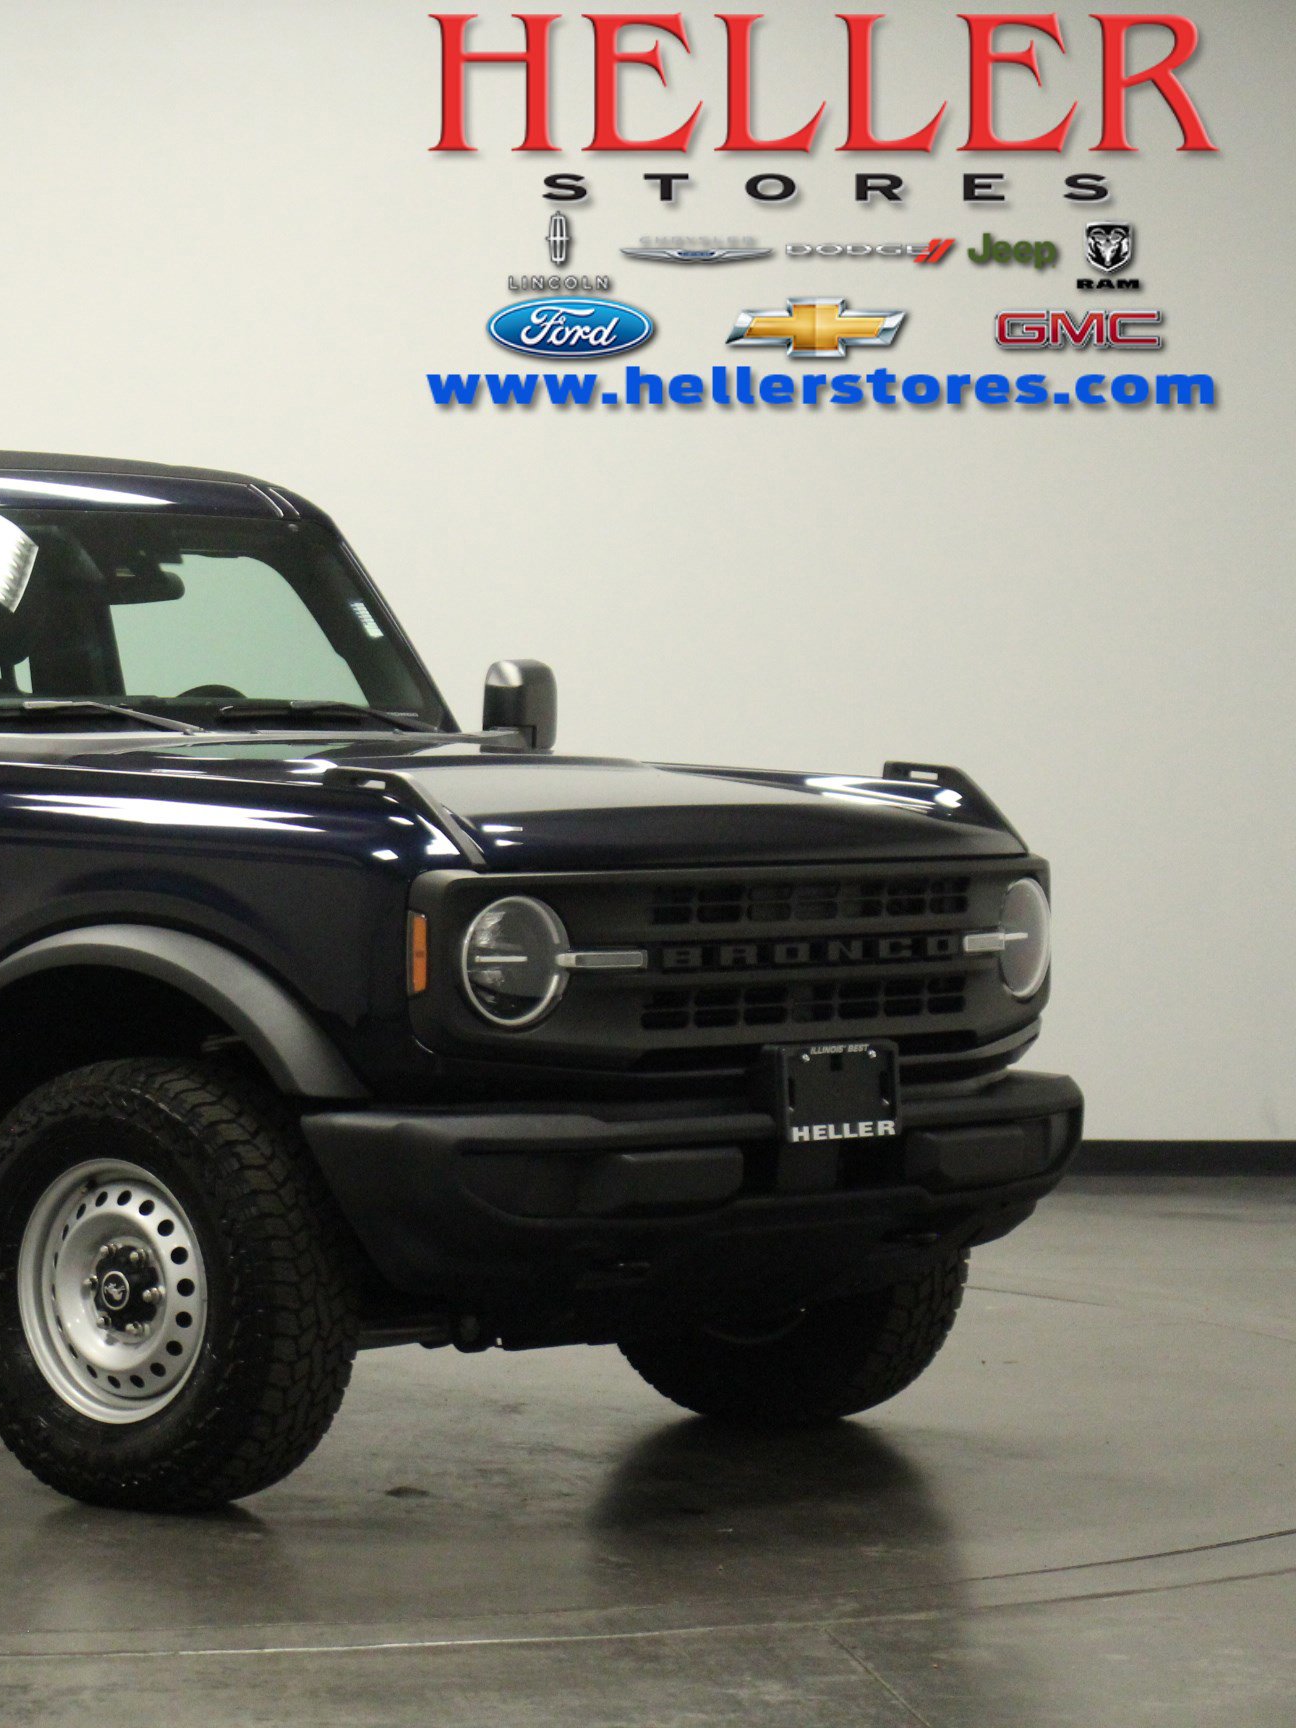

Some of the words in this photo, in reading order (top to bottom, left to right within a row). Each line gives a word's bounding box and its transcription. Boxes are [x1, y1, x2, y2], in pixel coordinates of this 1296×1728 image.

[661, 933, 960, 968] BRONCO
[847, 1043, 869, 1053] BEST
[791, 1120, 896, 1142] HELLER
